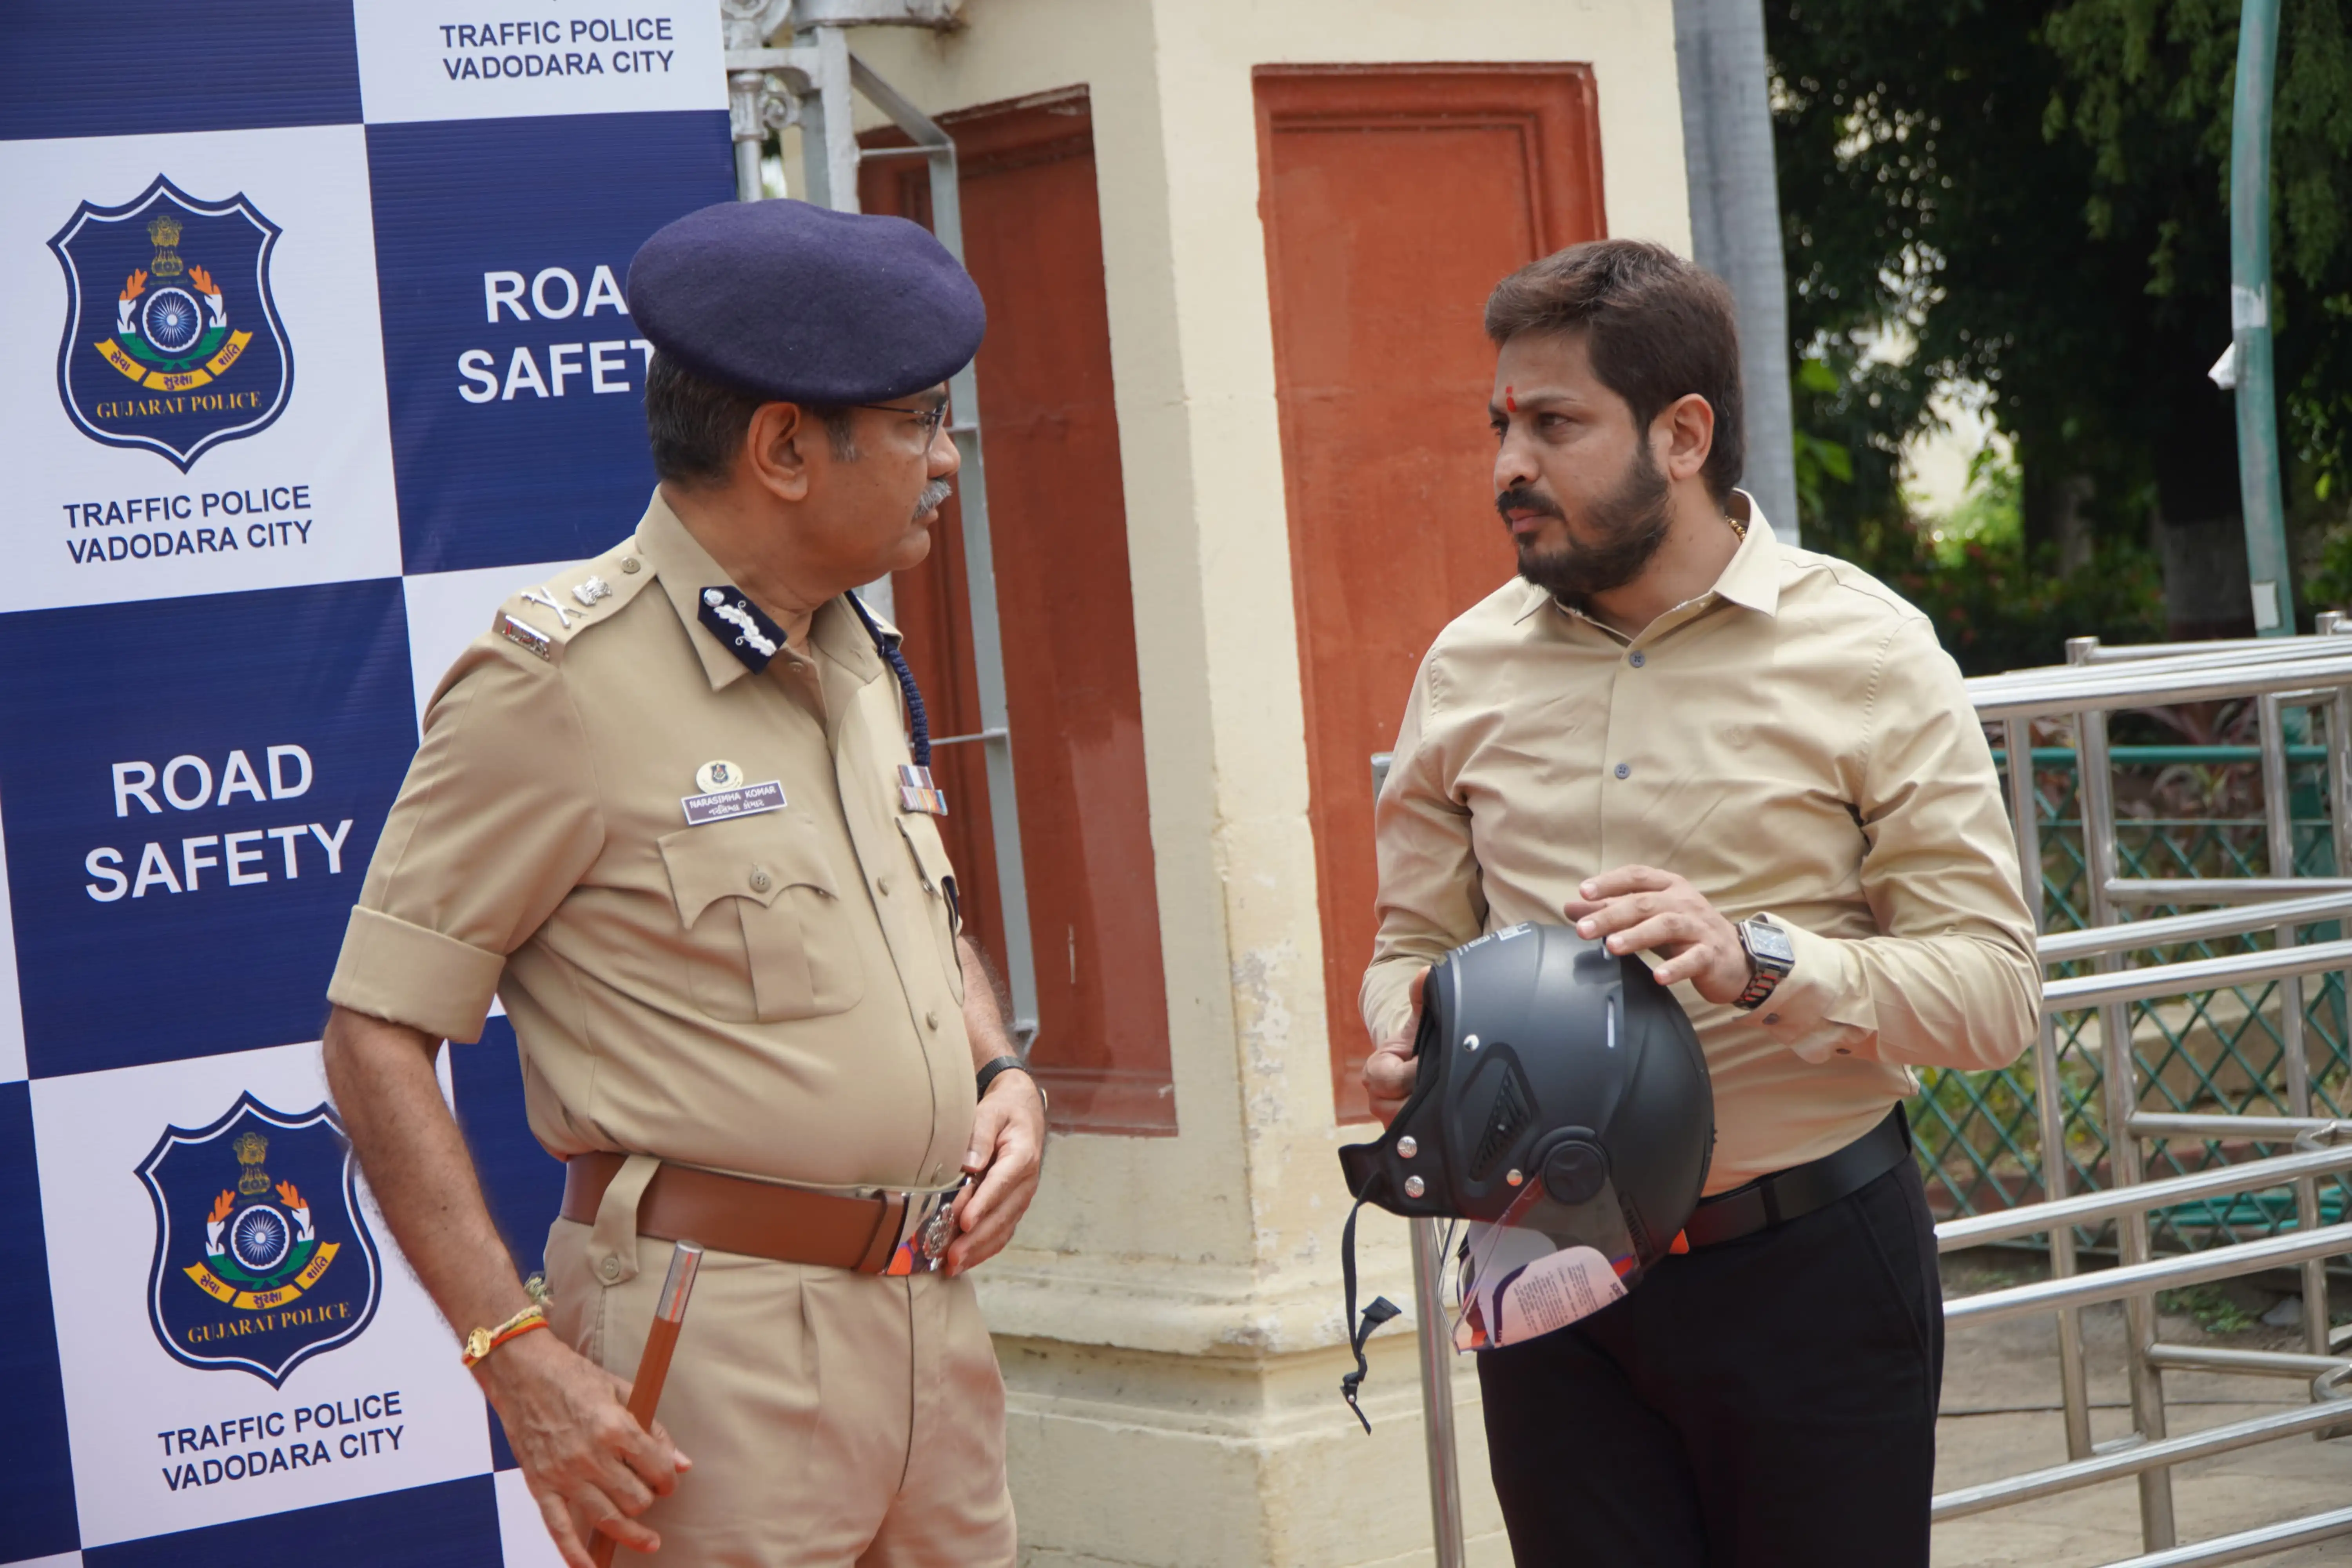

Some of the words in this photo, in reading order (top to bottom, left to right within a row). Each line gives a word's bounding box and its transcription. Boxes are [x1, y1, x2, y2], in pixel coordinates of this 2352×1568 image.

[439, 21, 561, 48] TRAFFIC
[570, 18, 673, 43] POLICE
[443, 53, 604, 80] VADODARA
[613, 50, 673, 73] CITY
[484, 265, 629, 323] ROA
[110, 351, 130, 372] સેવા
[163, 375, 192, 390] સુરક્ષા
[218, 343, 240, 365] શાંતિ
[458, 339, 655, 403] SAFE
[96, 397, 185, 418] GUJARAT
[191, 391, 262, 412] POLICE
[63, 495, 192, 528] TRAFFIC
[201, 485, 311, 517] POLICE
[66, 526, 238, 564] VADODARA
[247, 519, 312, 548] CITY
[112, 744, 313, 817] ROAD
[690, 792, 741, 808] NARASIMHA
[745, 786, 776, 798] KOMAR
[85, 819, 353, 902] SAFETY
[200, 1274, 220, 1294] સેવા
[253, 1292, 282, 1308] સુરક્ષા
[306, 1256, 328, 1279] શાંતિ
[188, 1315, 275, 1343] GUJARAT
[281, 1302, 351, 1328] POLICE
[158, 1412, 285, 1456] TRAFFIC
[294, 1391, 402, 1433] POLICE
[162, 1440, 331, 1491] VADODARA
[340, 1425, 404, 1459] CITY
